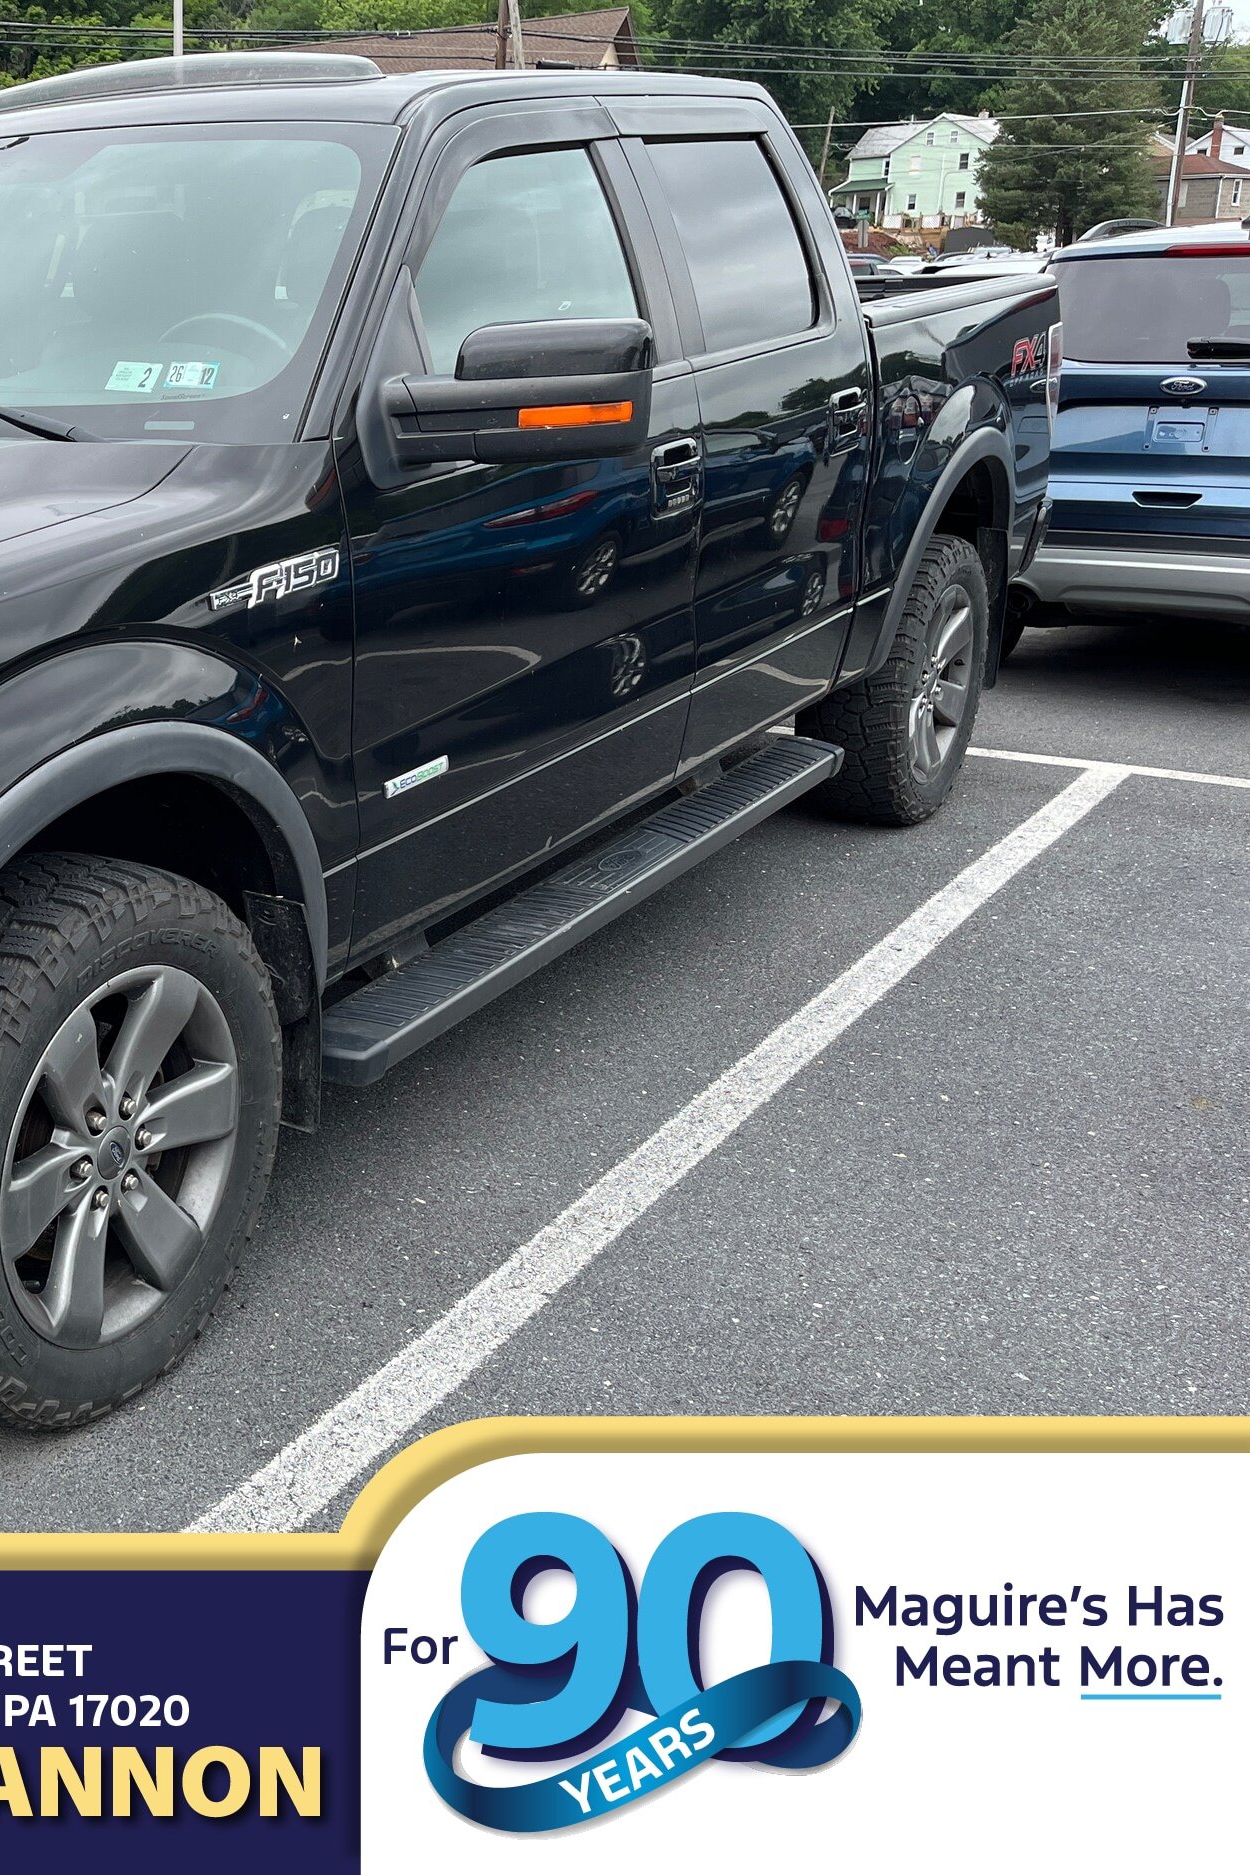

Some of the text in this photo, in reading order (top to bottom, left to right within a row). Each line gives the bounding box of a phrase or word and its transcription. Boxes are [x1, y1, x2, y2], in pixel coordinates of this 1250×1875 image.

[1011, 331, 1047, 379] FX4
[138, 367, 153, 388] 2
[169, 365, 216, 385] 26 12
[1170, 380, 1196, 391] Ford
[76, 927, 222, 994] DISCOVERER
